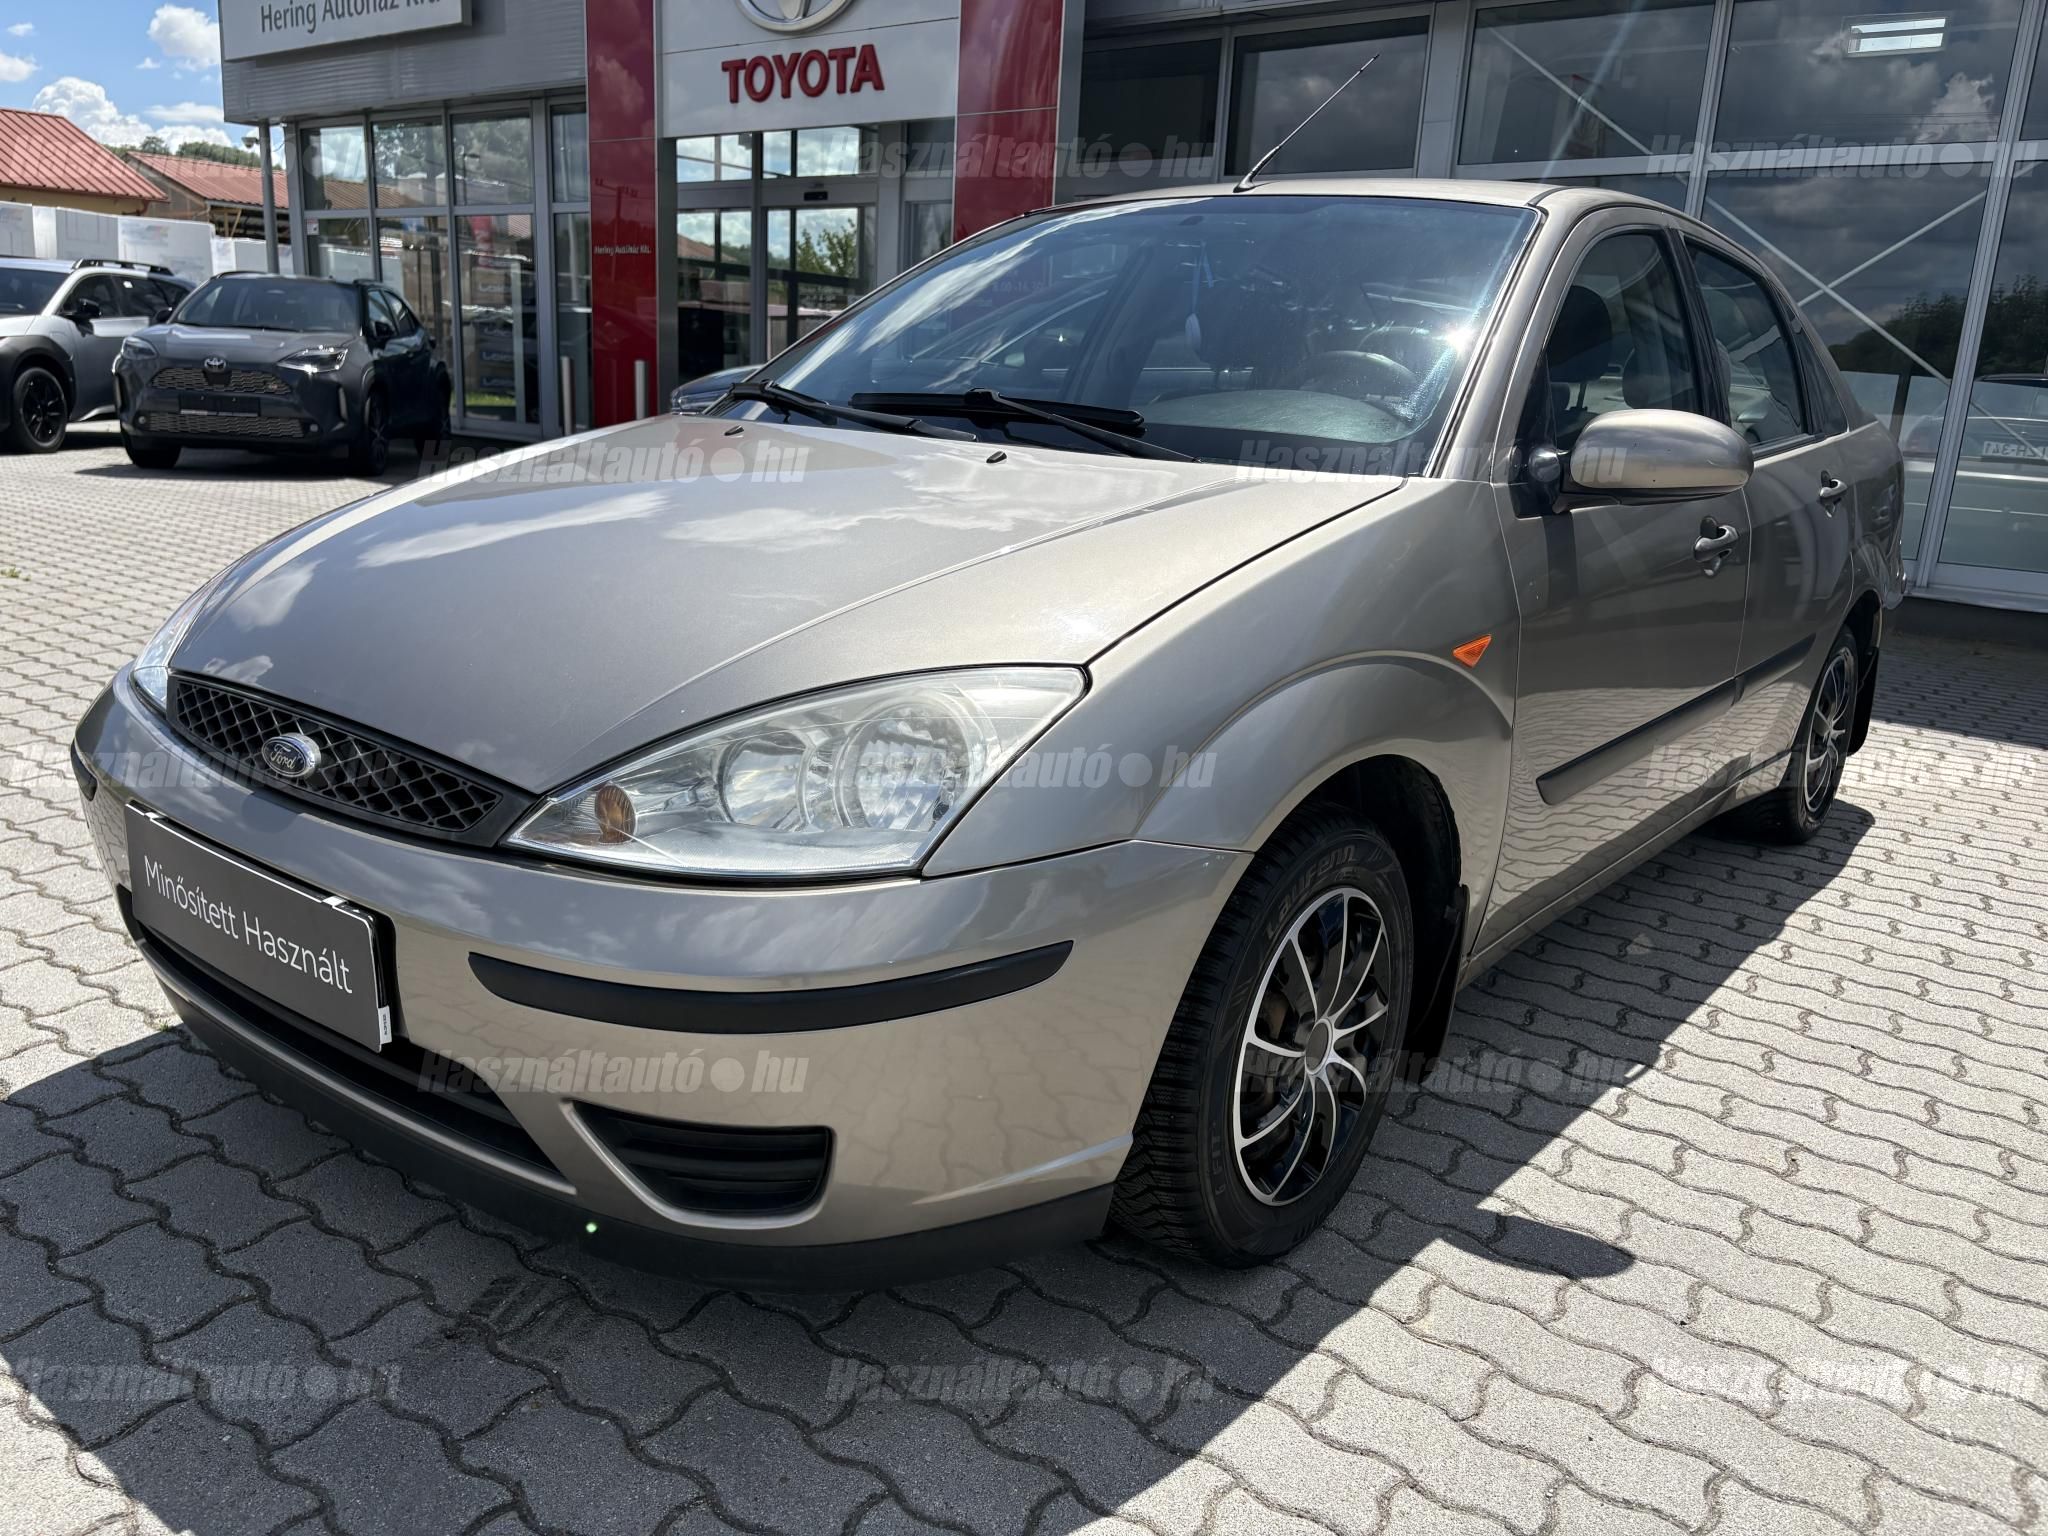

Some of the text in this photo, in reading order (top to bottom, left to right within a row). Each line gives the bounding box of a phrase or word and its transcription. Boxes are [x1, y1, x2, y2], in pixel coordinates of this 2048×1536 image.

[261, 1, 317, 34] Hering
[721, 44, 885, 104] TOYOTA
[144, 855, 354, 994] Minősített Használt
